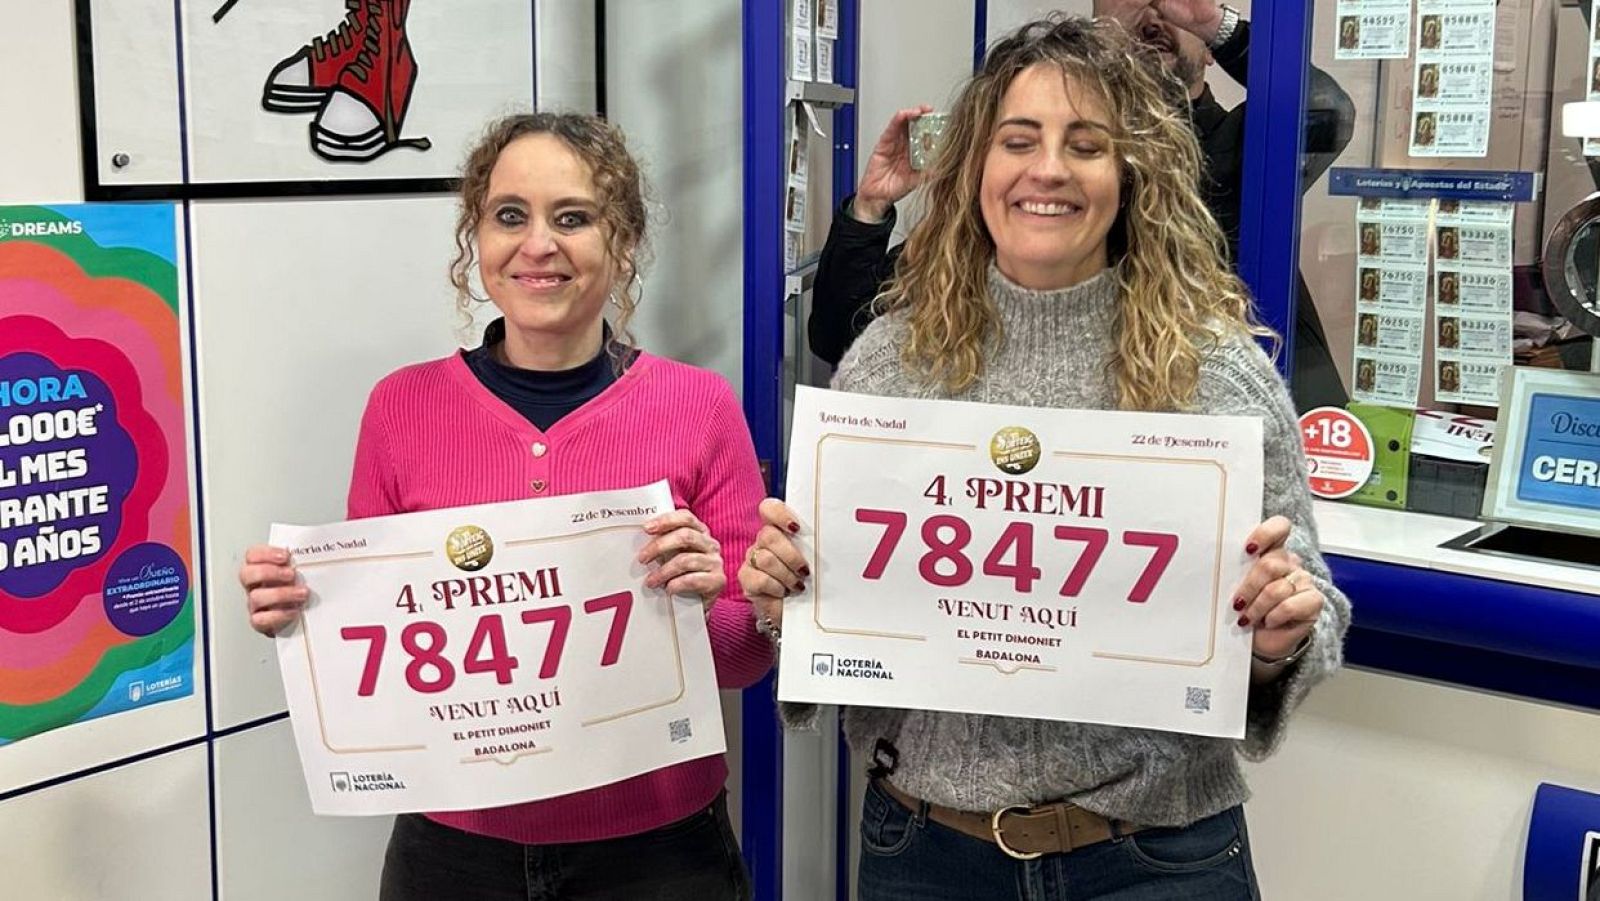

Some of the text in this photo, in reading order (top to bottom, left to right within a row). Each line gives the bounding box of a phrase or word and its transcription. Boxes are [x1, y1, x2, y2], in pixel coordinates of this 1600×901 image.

[1411, 180, 1454, 190] Apuestas
[1457, 180, 1472, 190] del
[11, 221, 82, 236] DREAMS
[860, 417, 872, 427] de
[875, 418, 907, 429] Nadal
[1131, 434, 1229, 448] 22 de Desembre
[1304, 418, 1352, 448] +18
[21, 449, 88, 485] MES
[1532, 455, 1600, 488] CER
[0, 486, 108, 528] RANTE
[966, 478, 1105, 518] PREMI
[572, 506, 657, 523] 22 de Desembre
[14, 526, 101, 568] AÑOS
[323, 544, 335, 552] de
[336, 538, 367, 549] Nadal
[856, 508, 1179, 603] 78477
[106, 576, 180, 596] EXTRAORDINARIO
[432, 566, 563, 610] PREMI
[938, 598, 1078, 628] VENUT AQUÍ
[340, 590, 634, 696] 78477
[957, 630, 1062, 648] EL PETIT DIMONIET
[837, 657, 883, 670] LOTERÍA
[976, 650, 1041, 664] BADALONA
[837, 667, 894, 680] NACIONAL
[430, 687, 562, 722] VENUT AQUÍ
[453, 720, 552, 742] EL PETIT DIMONIET
[474, 740, 536, 756] BADALONA
[352, 772, 394, 782] LOTERÍA
[354, 781, 406, 792] NACIONAL
